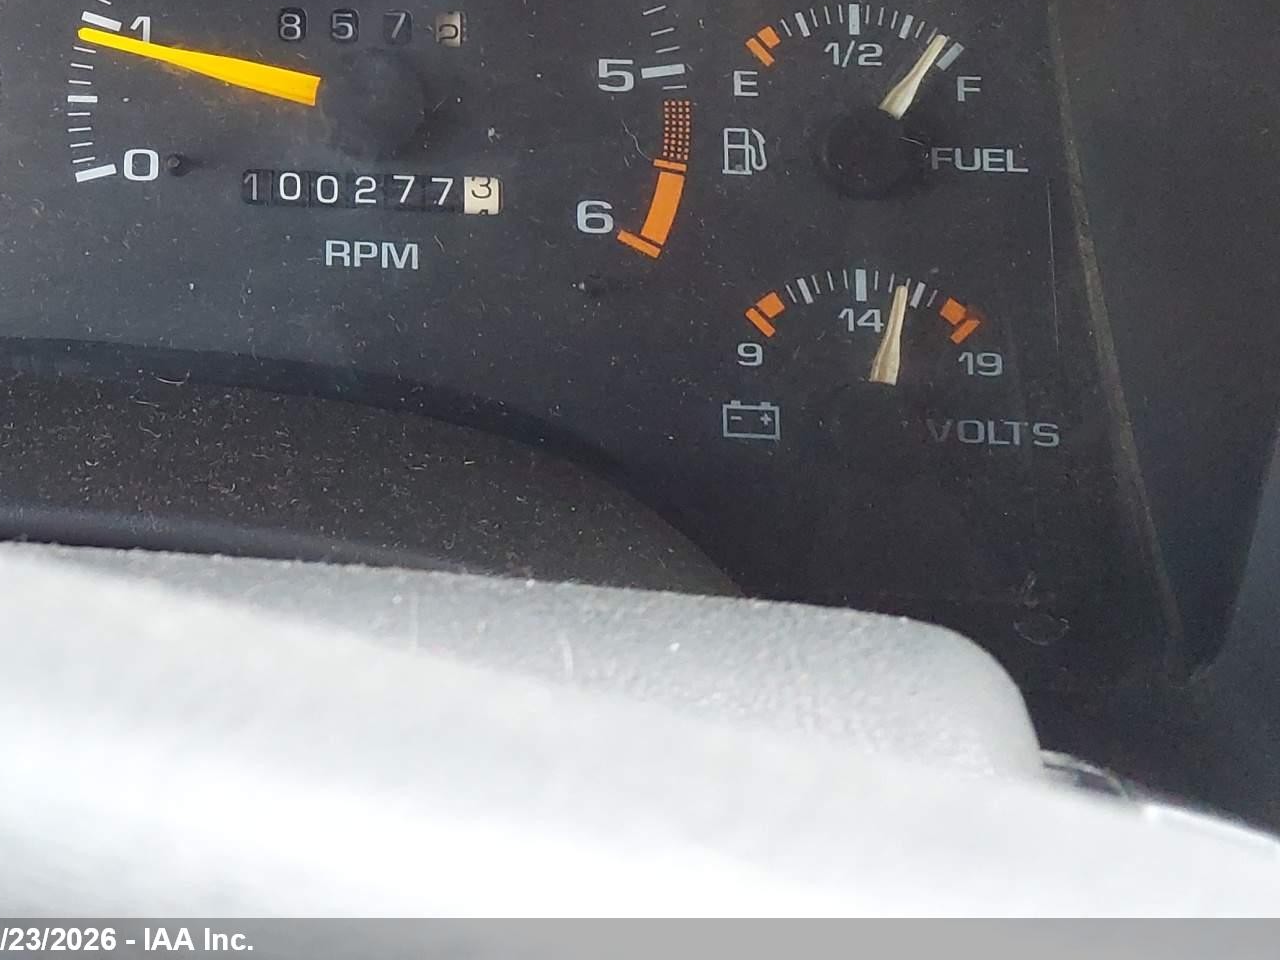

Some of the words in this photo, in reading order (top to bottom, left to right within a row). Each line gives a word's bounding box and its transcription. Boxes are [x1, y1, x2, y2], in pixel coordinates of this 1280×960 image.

[130, 16, 151, 44] 1
[824, 40, 883, 68] 1/2
[598, 58, 634, 92] 5
[733, 70, 759, 97] E
[957, 76, 982, 102] F
[123, 148, 159, 181] 0
[931, 147, 1029, 173] FUEL
[577, 200, 614, 234] 6
[325, 240, 419, 270] RPM
[838, 307, 884, 333] 14
[737, 343, 763, 367] 9
[958, 351, 1004, 376] 19
[926, 418, 1060, 447] VOLTS
